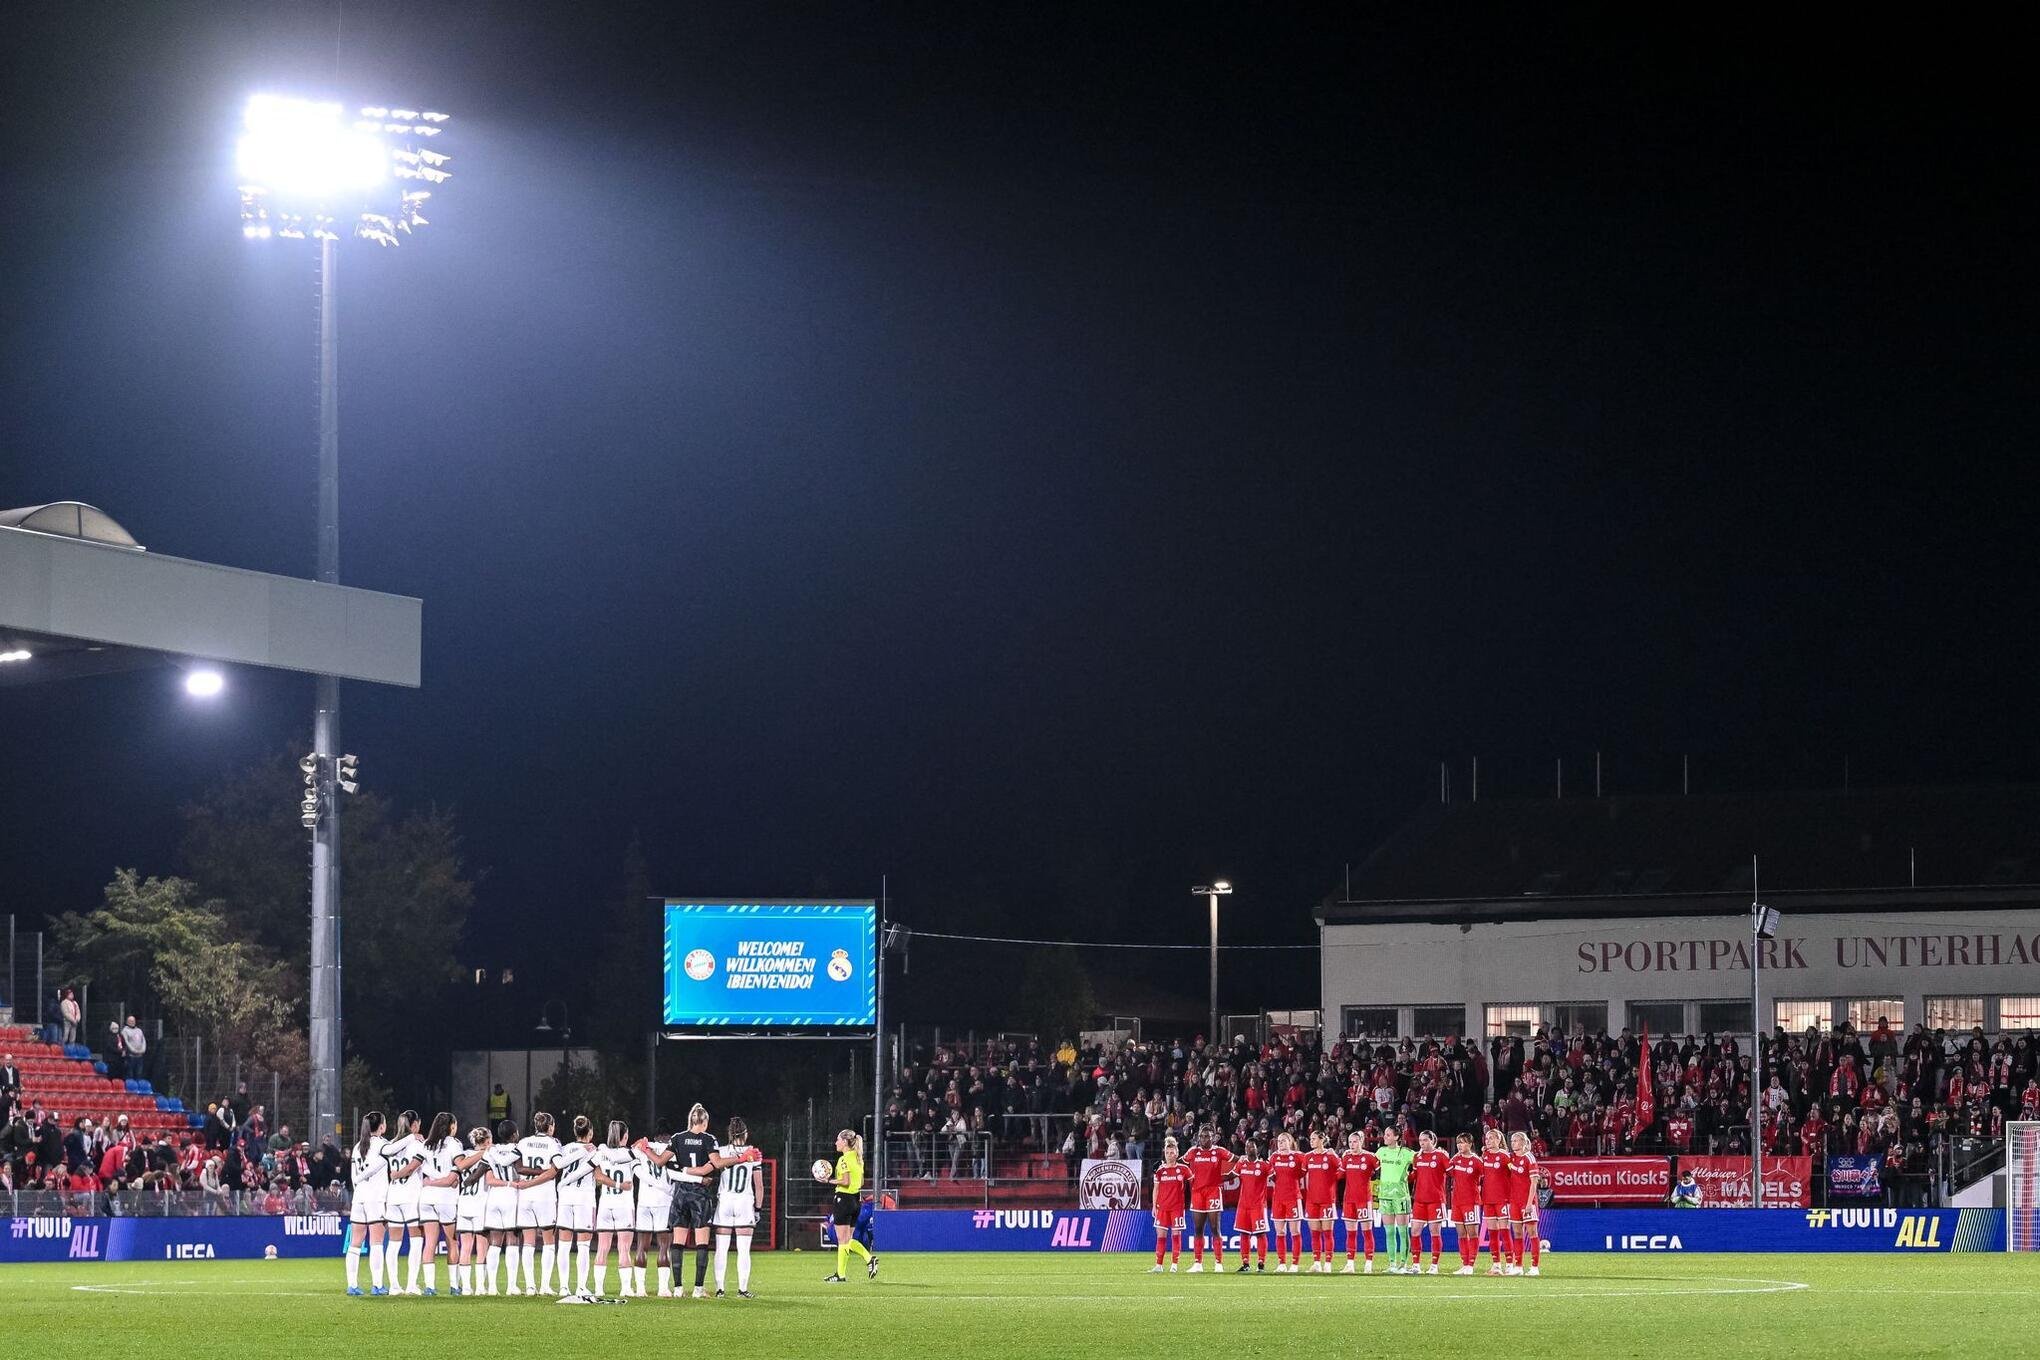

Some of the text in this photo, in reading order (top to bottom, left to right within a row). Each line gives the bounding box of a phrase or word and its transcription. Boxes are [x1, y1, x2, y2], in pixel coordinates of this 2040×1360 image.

[737, 941, 804, 956] WELCOME!
[1578, 938, 1809, 974] SPORTPARK
[726, 958, 816, 973] WILLKOMMEN!
[689, 1152, 697, 1167] 1
[1554, 1170, 1611, 1186] Sektion
[1616, 1170, 1657, 1185] Kiosk
[1659, 1171, 1668, 1185] 5
[1085, 1182, 1136, 1198] W@W
[1209, 1199, 1220, 1209] 29
[1322, 1208, 1333, 1218] 17
[1357, 1208, 1368, 1218] 20
[1464, 1211, 1475, 1222] 18
[1174, 1217, 1184, 1227] 10
[1255, 1220, 1266, 1231] 15
[1051, 1217, 1091, 1246] ALL
[1895, 1216, 1941, 1247] ALL
[69, 1225, 99, 1258] ALL
